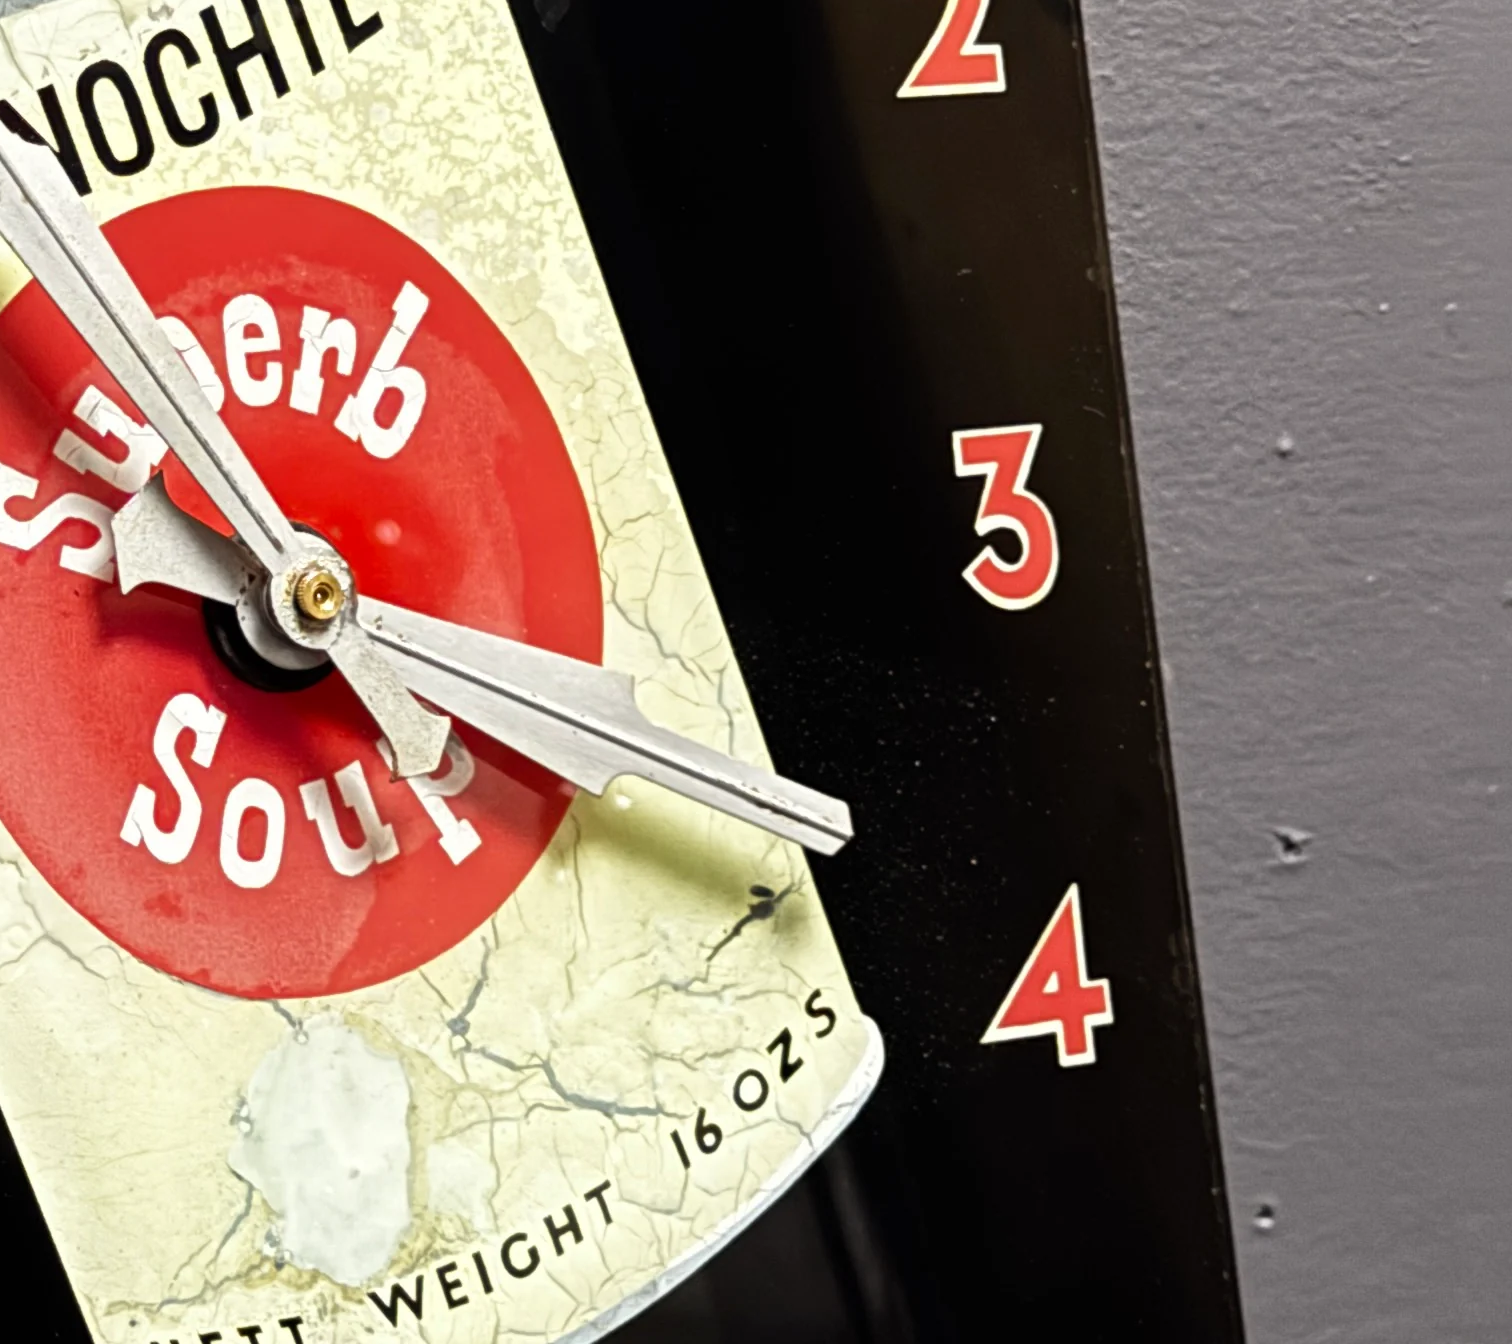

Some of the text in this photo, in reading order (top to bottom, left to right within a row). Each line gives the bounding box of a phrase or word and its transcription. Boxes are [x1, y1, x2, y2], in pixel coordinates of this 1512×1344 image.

[952, 424, 1058, 610] 3
[119, 692, 482, 889] Soup
[980, 883, 1113, 1067] 4
[366, 1180, 616, 1329] WEIGHT
